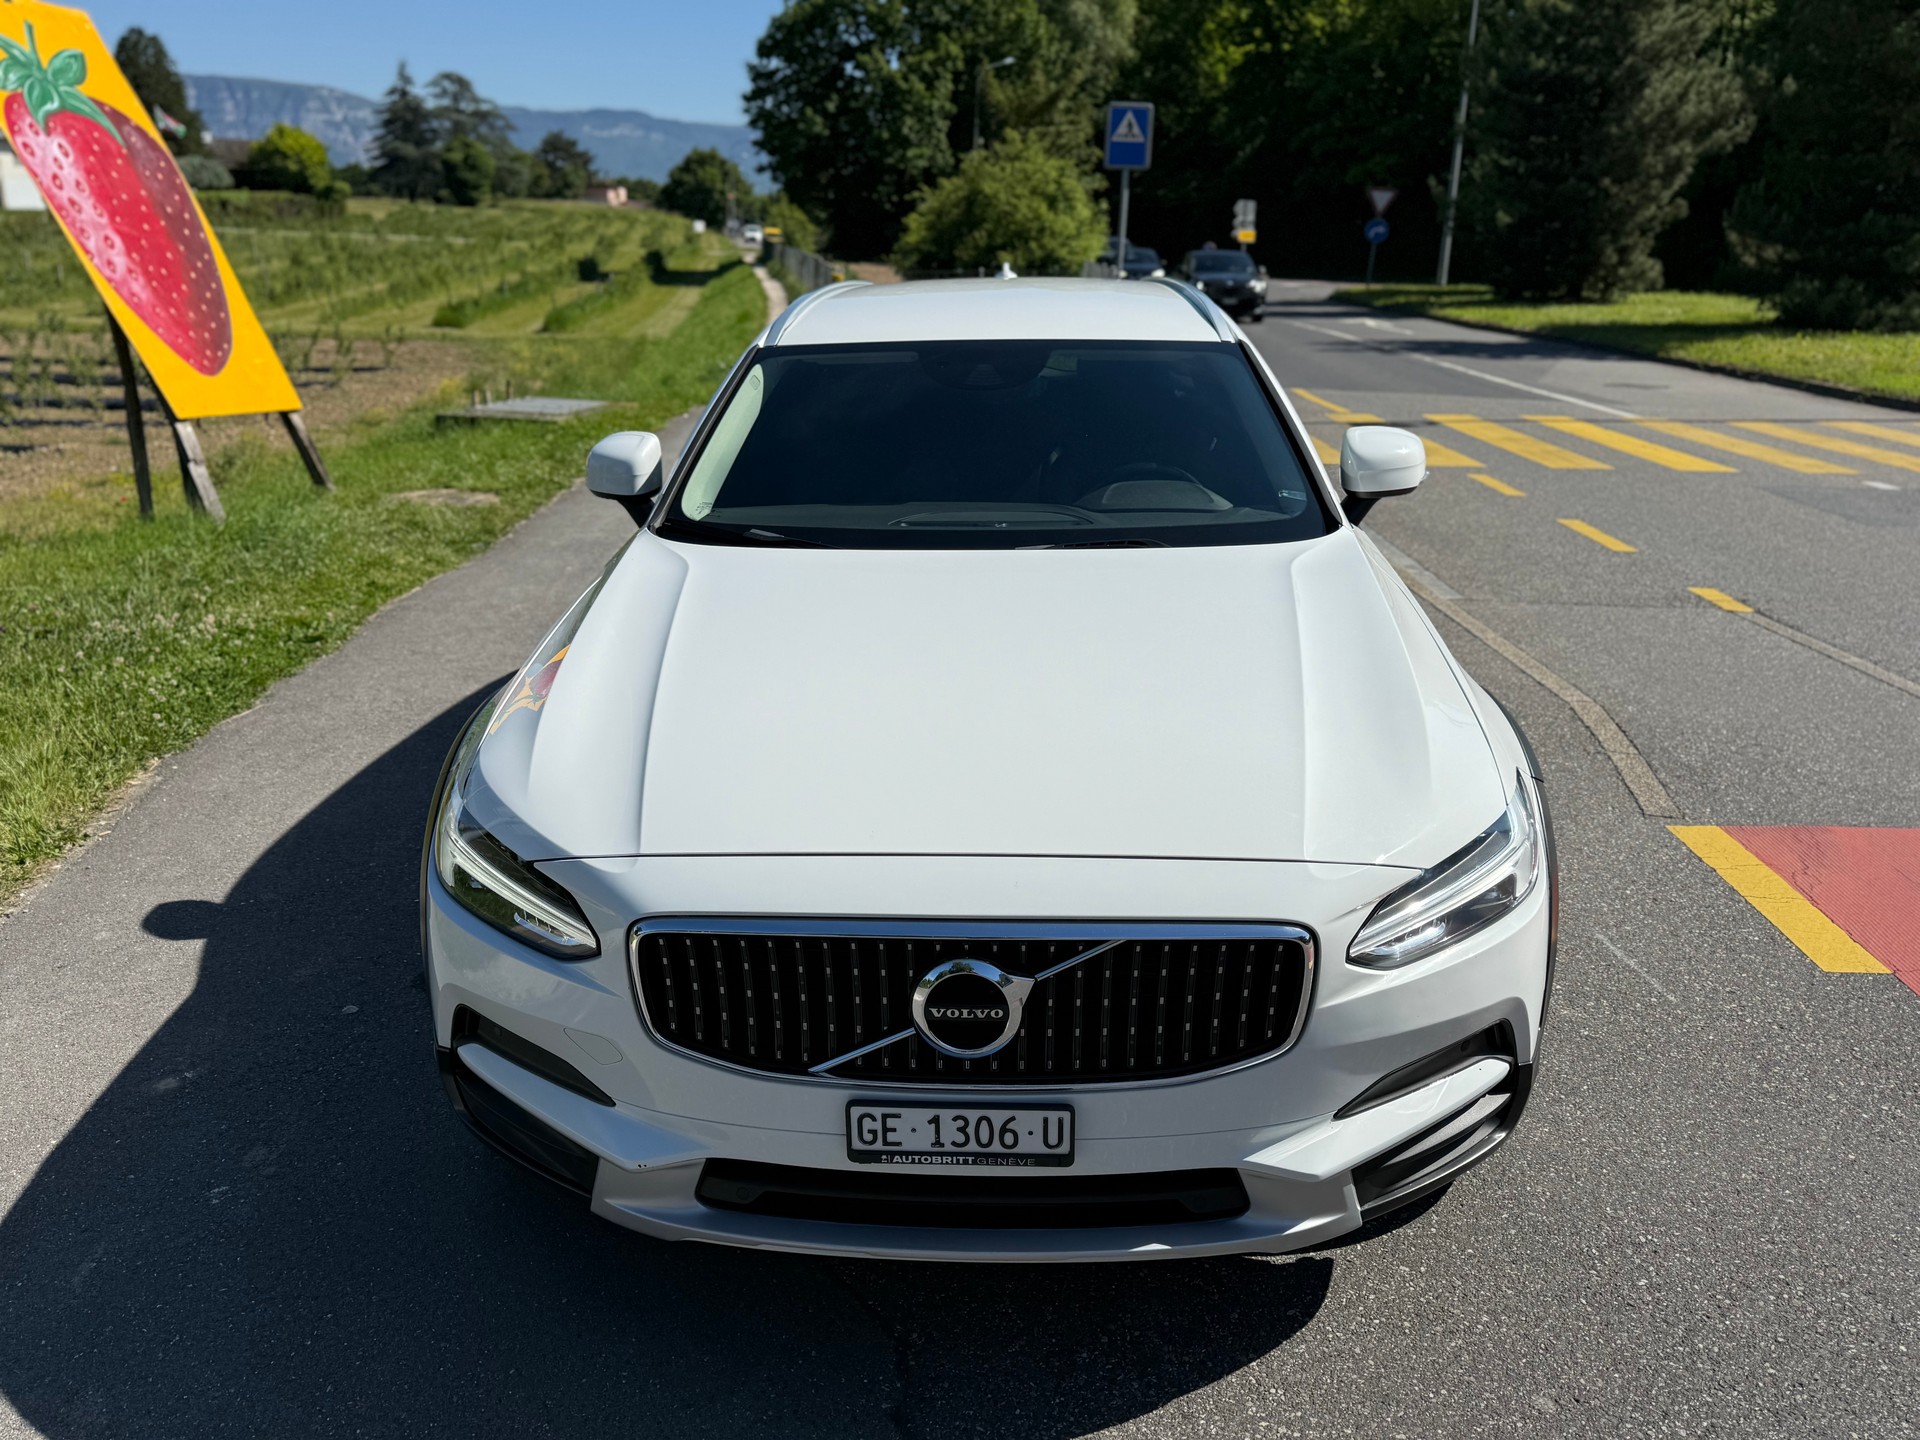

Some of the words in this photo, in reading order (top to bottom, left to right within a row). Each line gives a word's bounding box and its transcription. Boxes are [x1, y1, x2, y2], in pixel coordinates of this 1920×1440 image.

[928, 1007, 1004, 1019] VOLVO
[892, 1155, 975, 1165] AUTOBRITT
[976, 1156, 1036, 1166] GENÈVE
